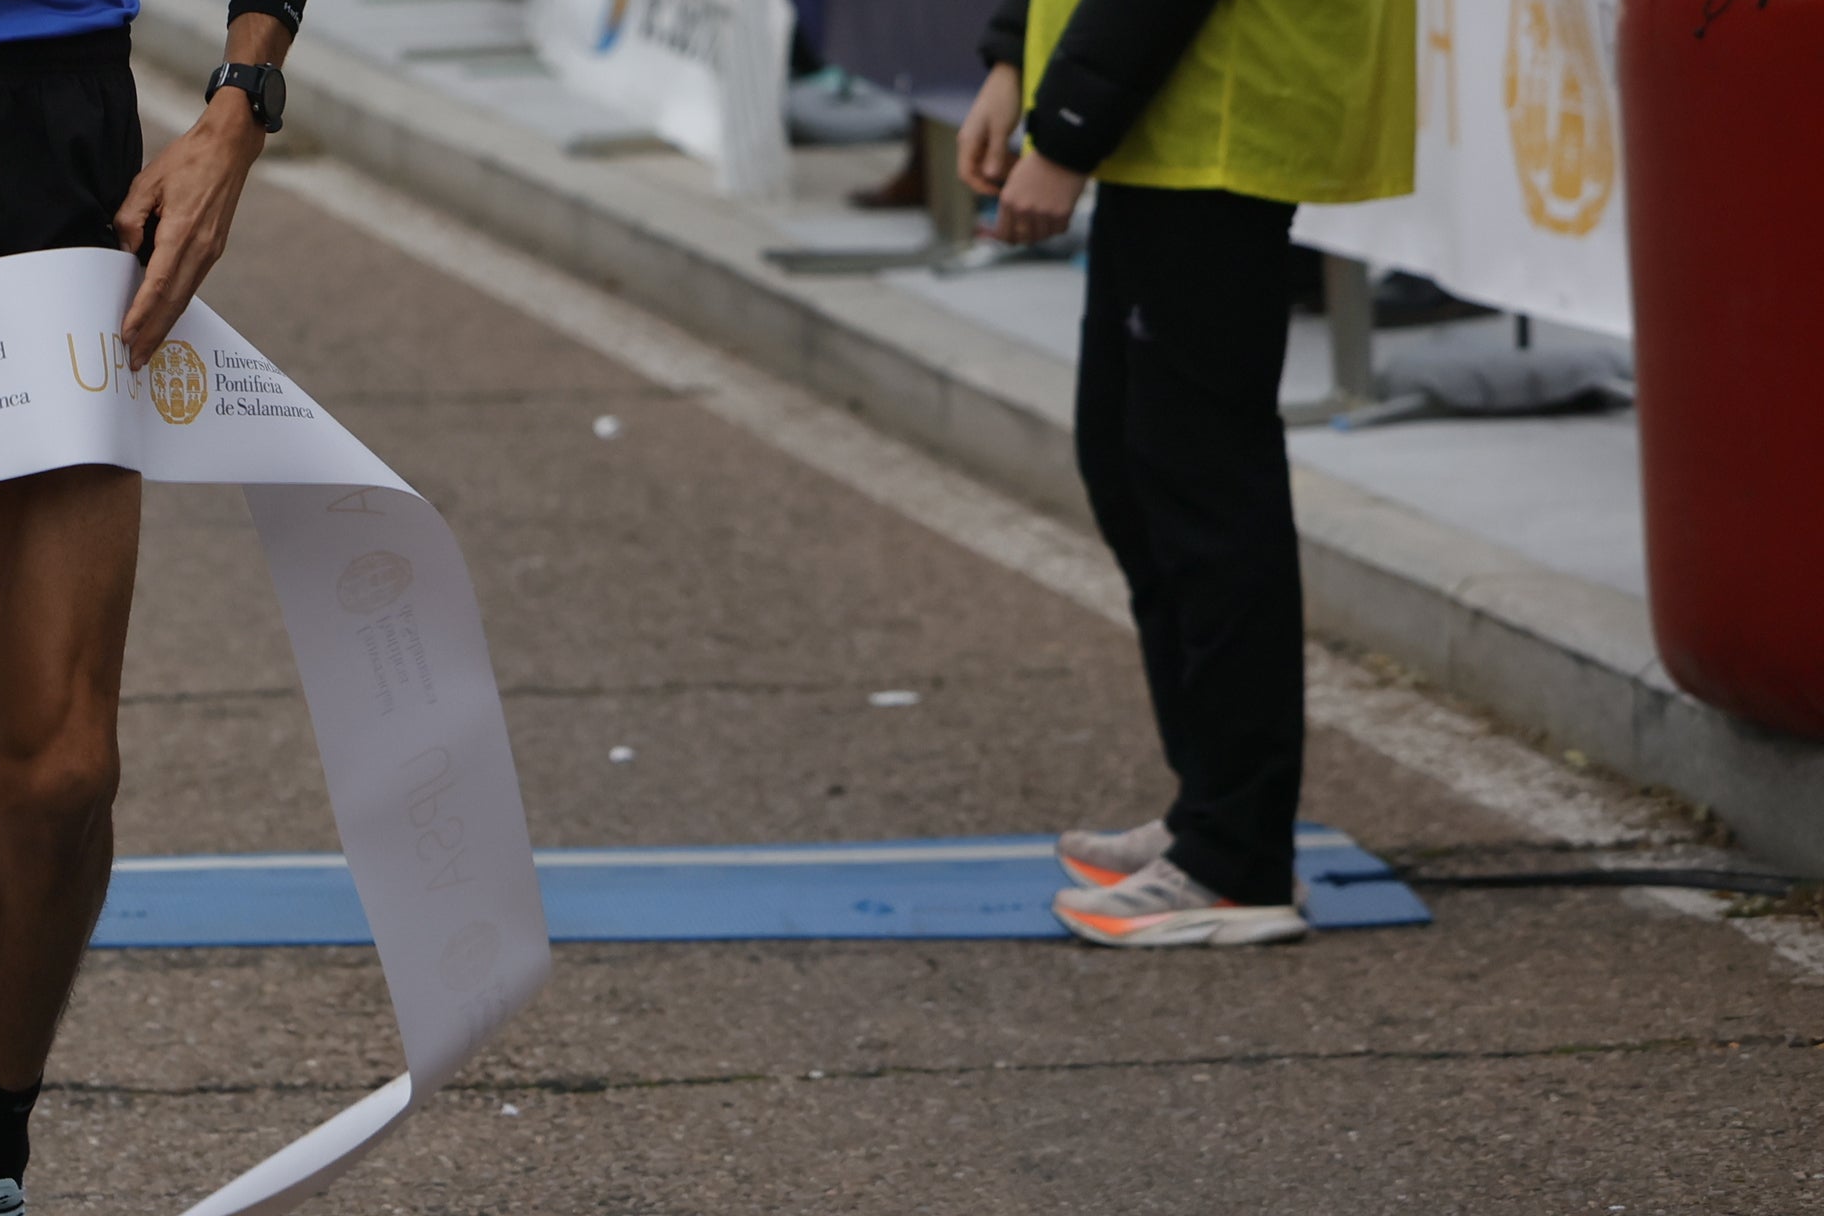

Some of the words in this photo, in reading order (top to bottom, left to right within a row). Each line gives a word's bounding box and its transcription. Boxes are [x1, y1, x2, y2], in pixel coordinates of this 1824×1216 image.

[215, 373, 283, 395] Pontificia
[216, 400, 234, 416] de
[237, 398, 314, 419] Salamanca
